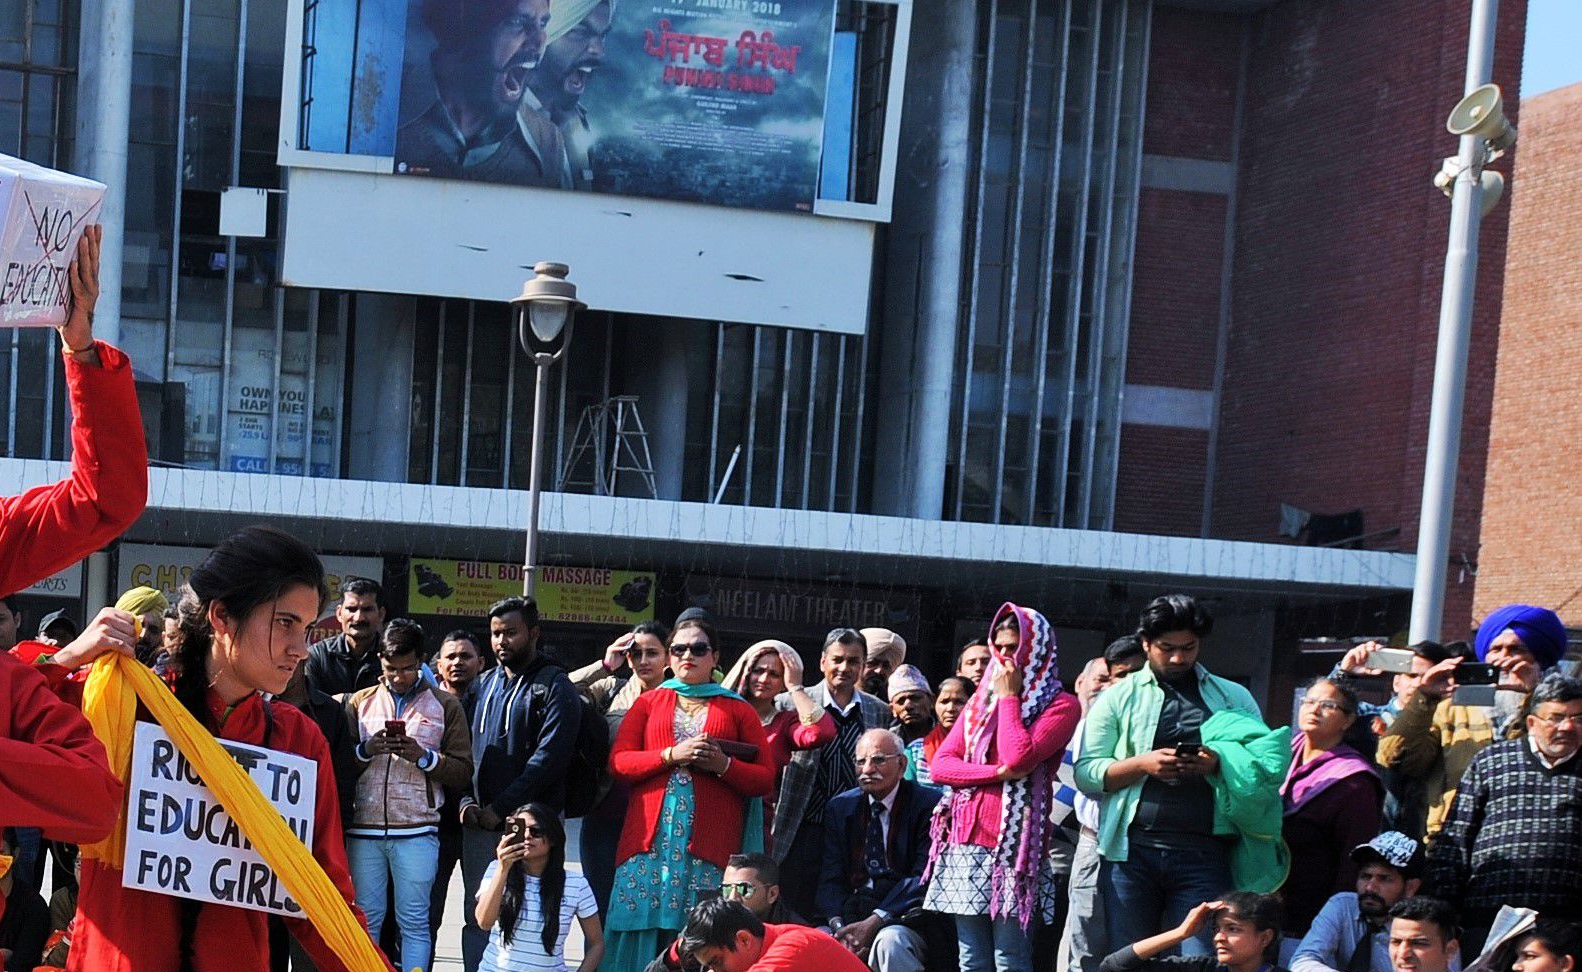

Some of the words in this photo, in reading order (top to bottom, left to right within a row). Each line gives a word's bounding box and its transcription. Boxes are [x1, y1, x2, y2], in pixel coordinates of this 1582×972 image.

[752, 1, 781, 15] 2018
[33, 206, 74, 252] NO
[456, 562, 492, 580] FULL
[542, 567, 611, 586] MASSAGE
[717, 589, 798, 622] NEELAM
[804, 595, 886, 627] THEATER
[266, 763, 302, 805] TO
[137, 850, 192, 894] FOR
